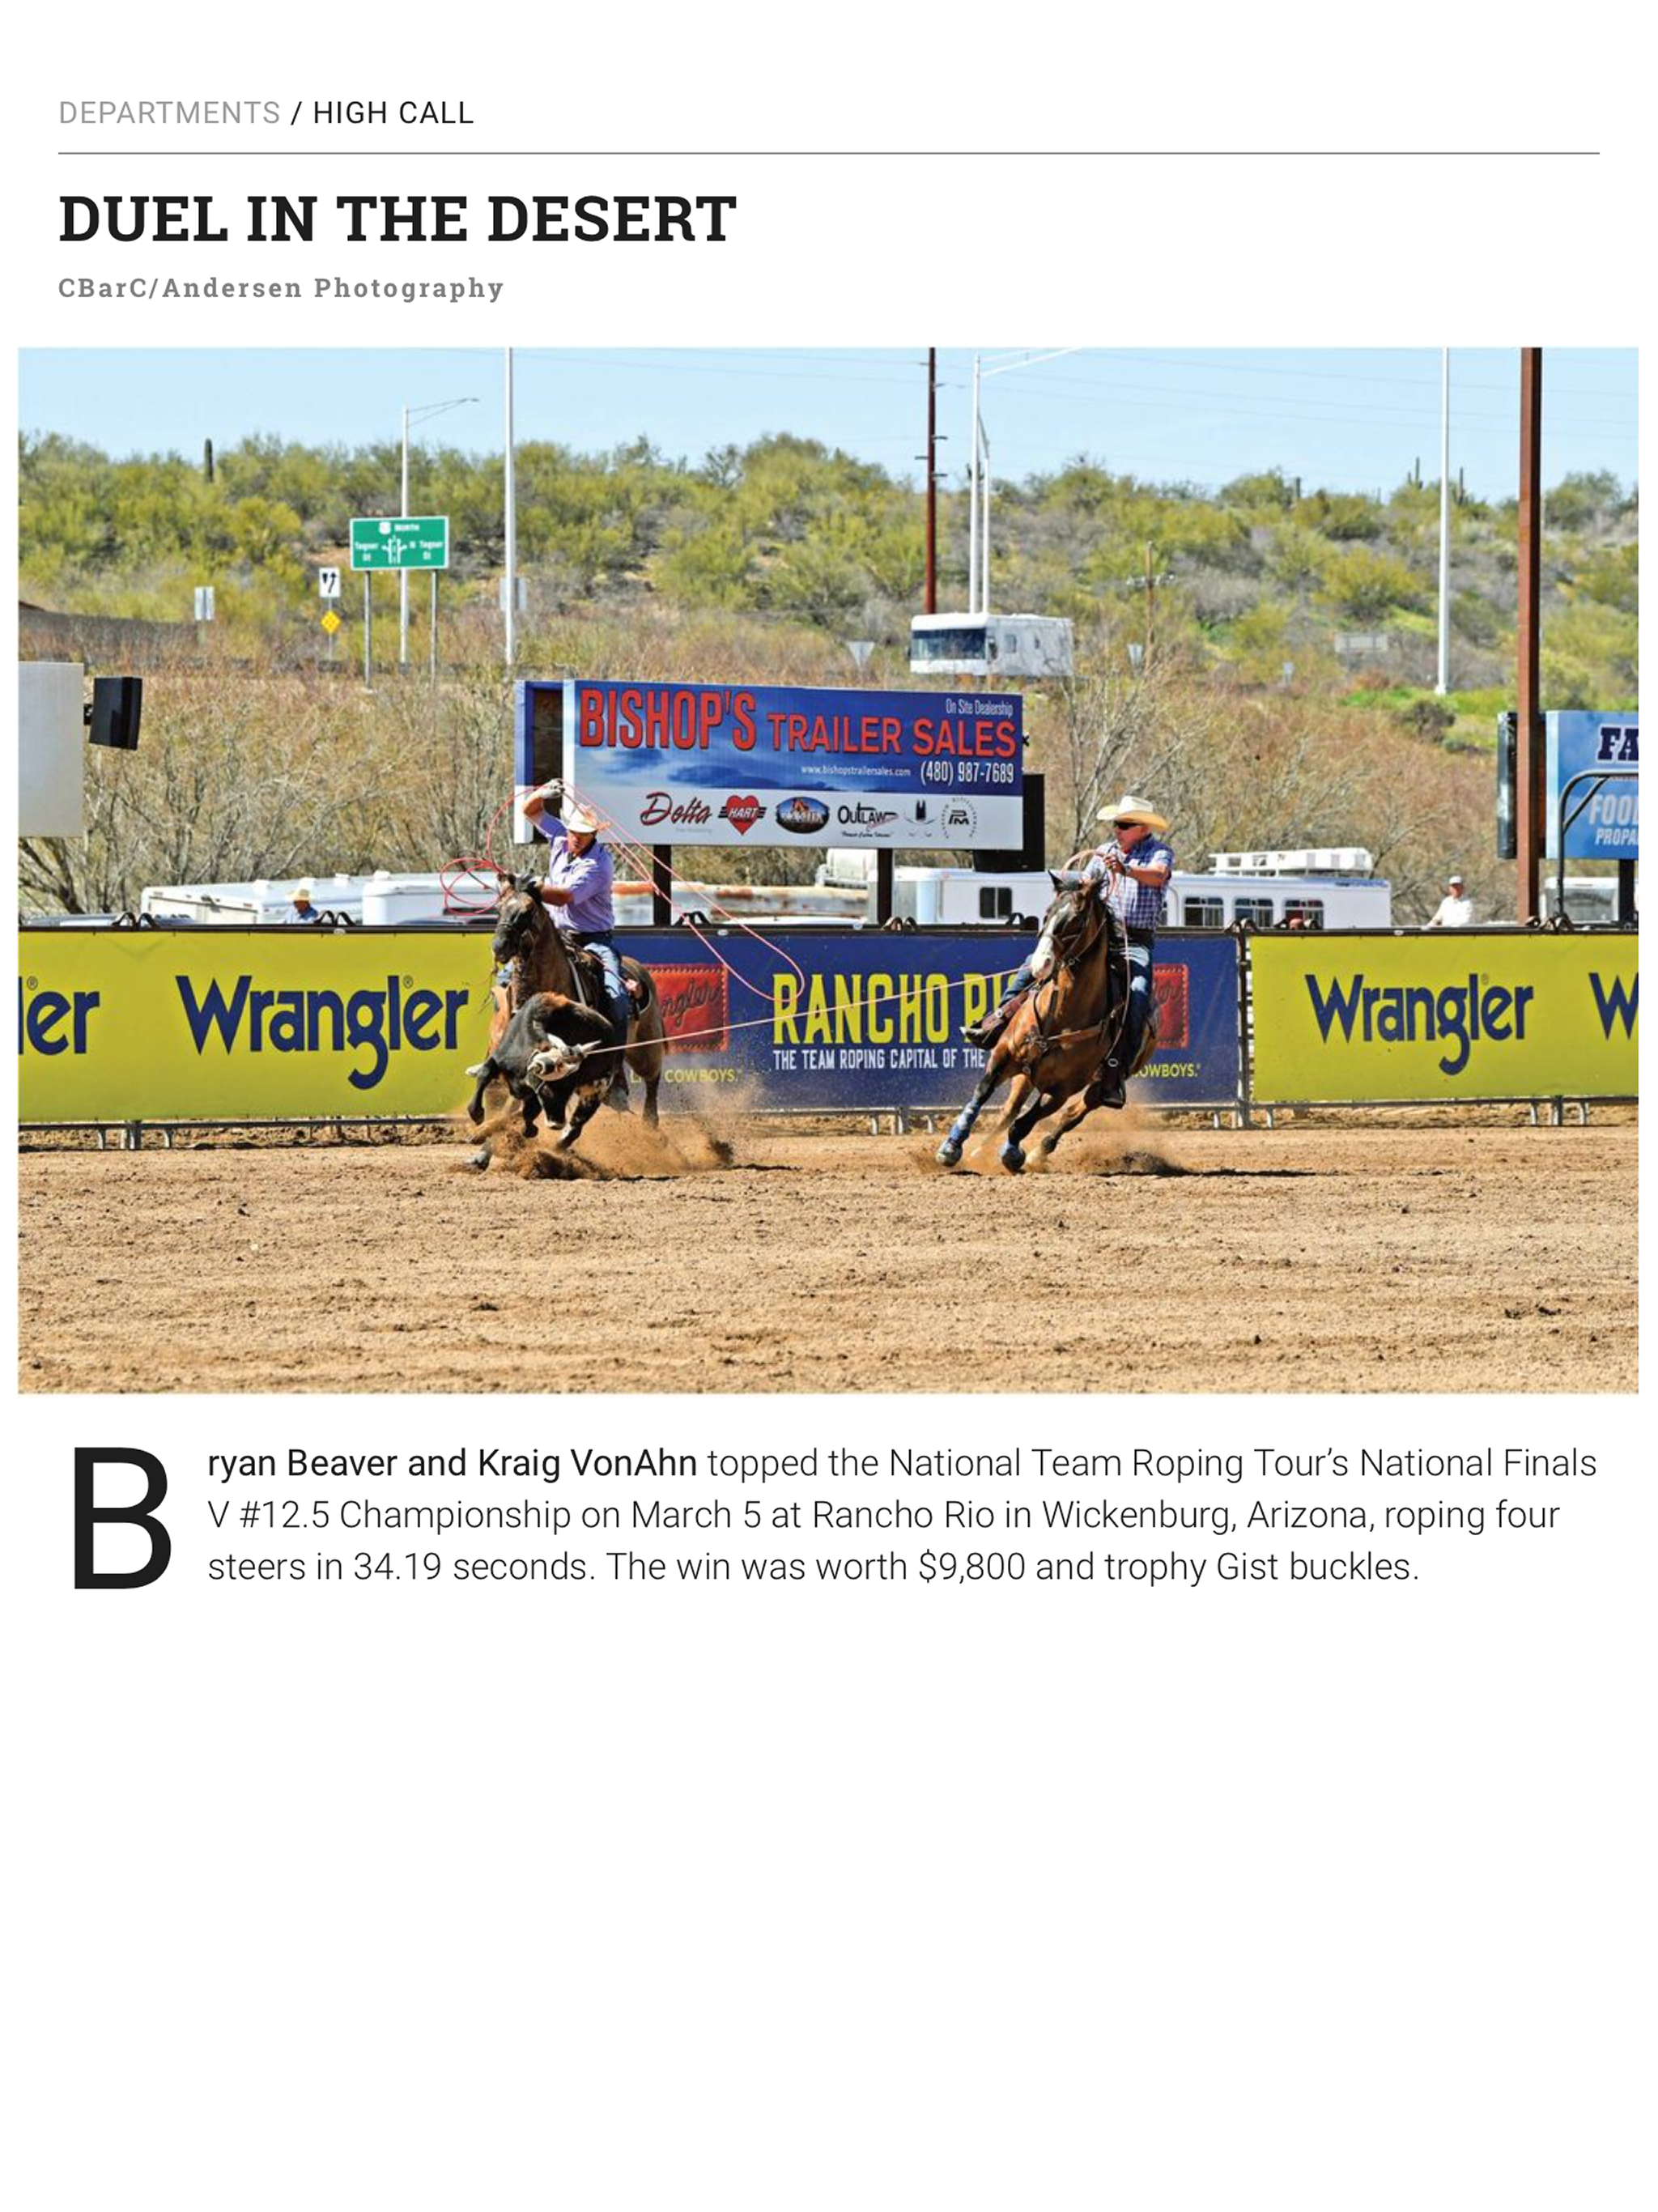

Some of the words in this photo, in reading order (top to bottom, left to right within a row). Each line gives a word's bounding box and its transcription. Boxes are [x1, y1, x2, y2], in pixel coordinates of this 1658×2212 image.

[580, 689, 757, 751] BISHOP'S
[767, 713, 903, 755] TRAILER
[912, 718, 1017, 758] SALES
[946, 699, 957, 713] On
[959, 699, 973, 715] Site
[975, 700, 1013, 719] Dealership
[801, 764, 911, 777] www.bishopstrailersales.com
[920, 760, 954, 785] (480)
[958, 763, 1014, 784] 987-7689
[640, 791, 712, 827] Delta
[729, 806, 759, 819] HART
[773, 974, 950, 1044] RANCHO
[963, 973, 1018, 1044] RI
[175, 975, 470, 1090] Wrangler
[1305, 973, 1533, 1075] Wrangler
[773, 1050, 797, 1070] THE
[802, 1050, 835, 1070] TEAM
[840, 1049, 885, 1069] ROPING
[891, 1049, 937, 1069] CAPITAL
[942, 1049, 958, 1068] OF
[963, 1048, 985, 1068] THE
[1131, 1062, 1198, 1078] OWBOYS.
